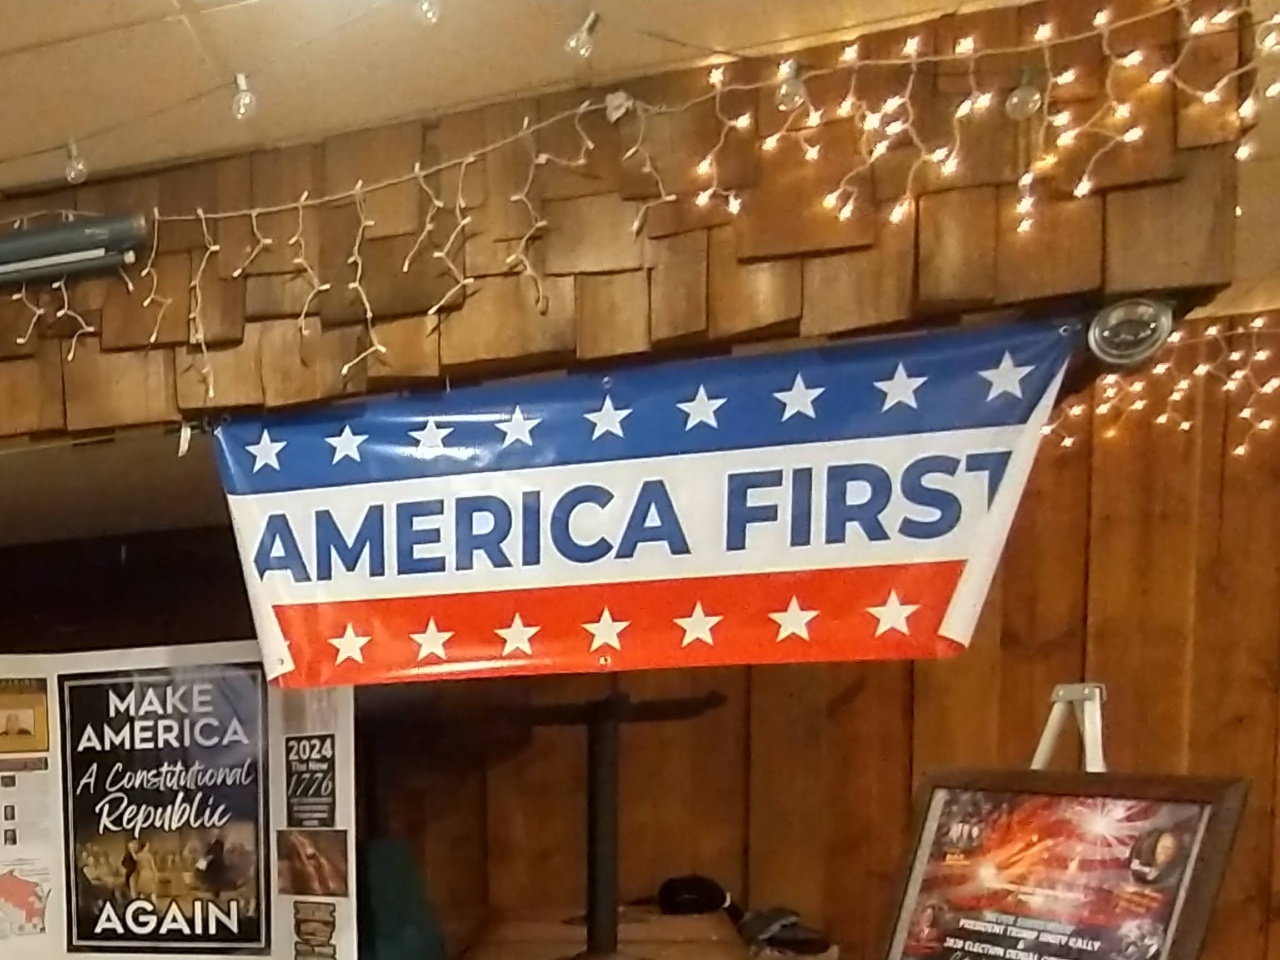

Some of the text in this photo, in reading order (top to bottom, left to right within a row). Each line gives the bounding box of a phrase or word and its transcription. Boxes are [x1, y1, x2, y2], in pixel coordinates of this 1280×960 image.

[253, 480, 690, 583] AMERICA
[108, 684, 214, 719] MAKE
[77, 717, 250, 753] AMERICA
[287, 738, 334, 761] 2024
[76, 762, 97, 795] A
[106, 757, 256, 793] Constitutional
[287, 771, 334, 798] 1776
[94, 791, 233, 839] Republic
[93, 899, 240, 936] AGAIN
